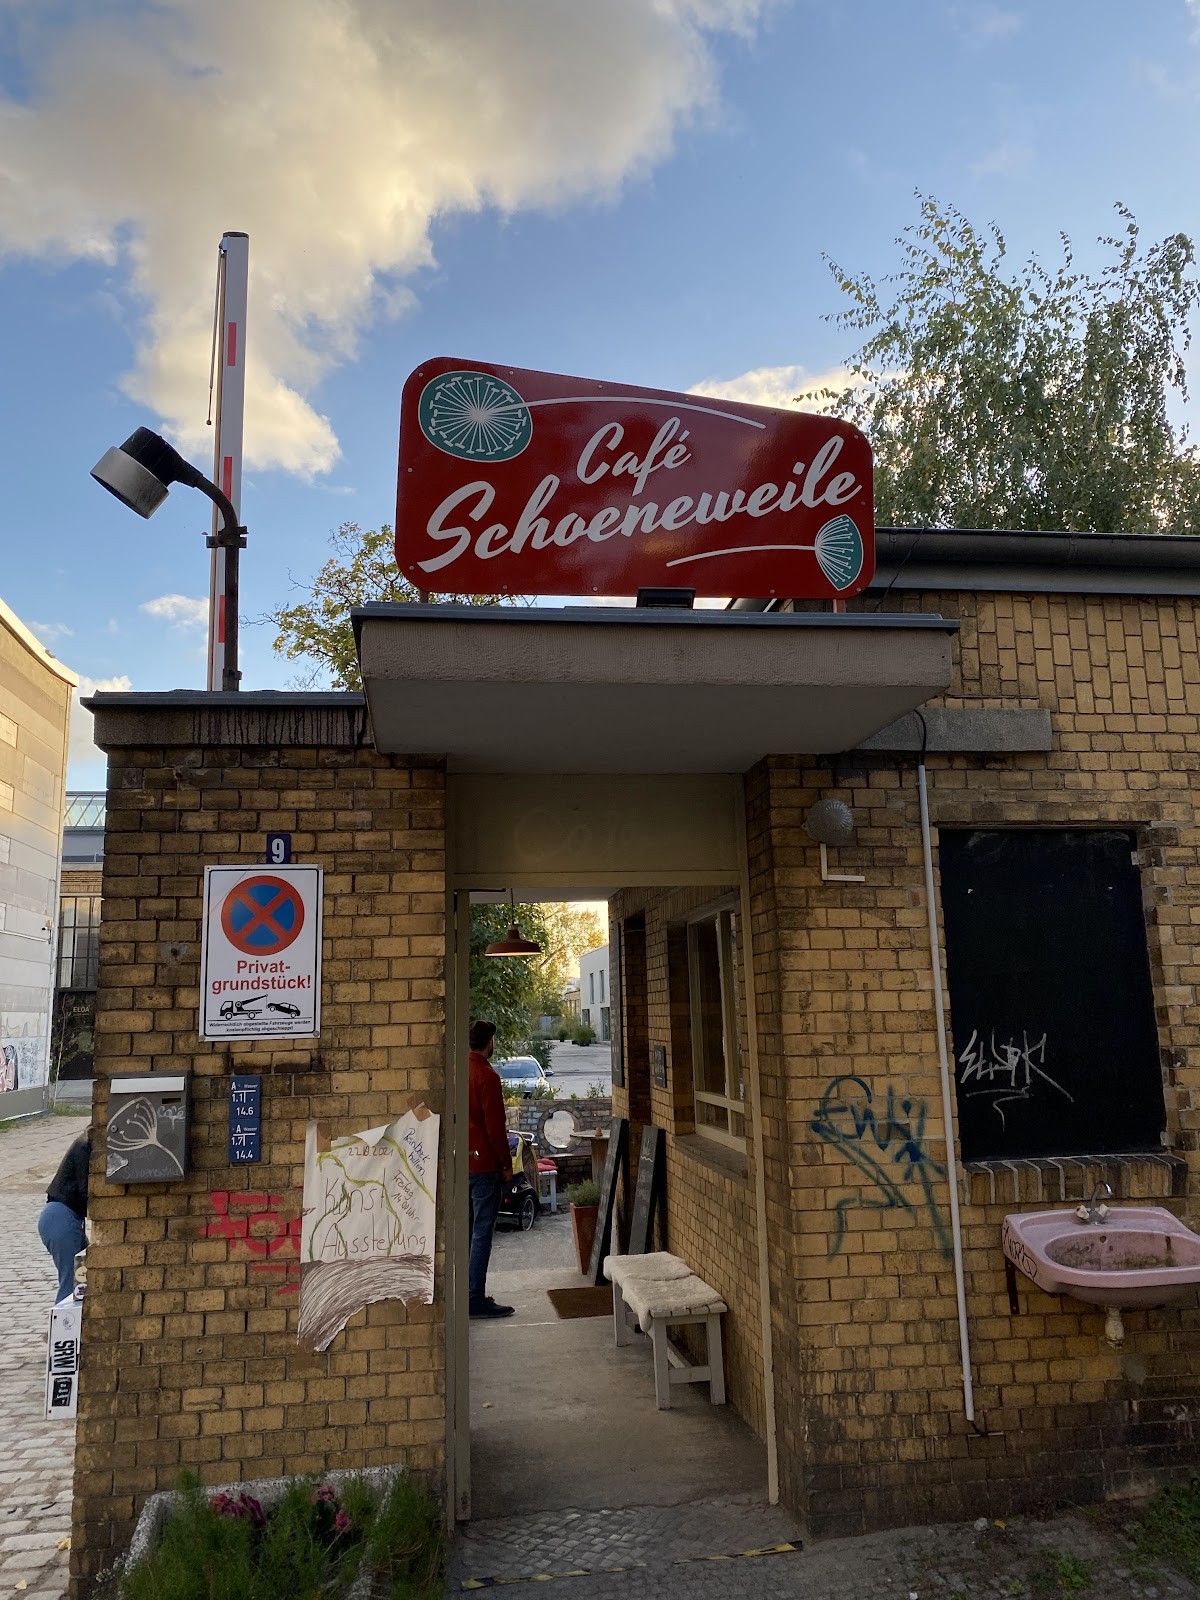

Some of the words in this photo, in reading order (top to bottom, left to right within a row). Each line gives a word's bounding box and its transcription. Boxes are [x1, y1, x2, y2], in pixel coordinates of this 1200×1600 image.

[576, 416, 693, 496] Café
[416, 434, 863, 573] Schoeneweile
[271, 838, 285, 864] 9
[236, 959, 291, 974] Privat-
[211, 975, 312, 995] grundstück!
[231, 1081, 236, 1090] A
[236, 1106, 254, 1116] 14.6
[235, 1124, 241, 1133] A
[235, 1149, 253, 1160] 14.4
[320, 1213, 427, 1259] Ausstellung
